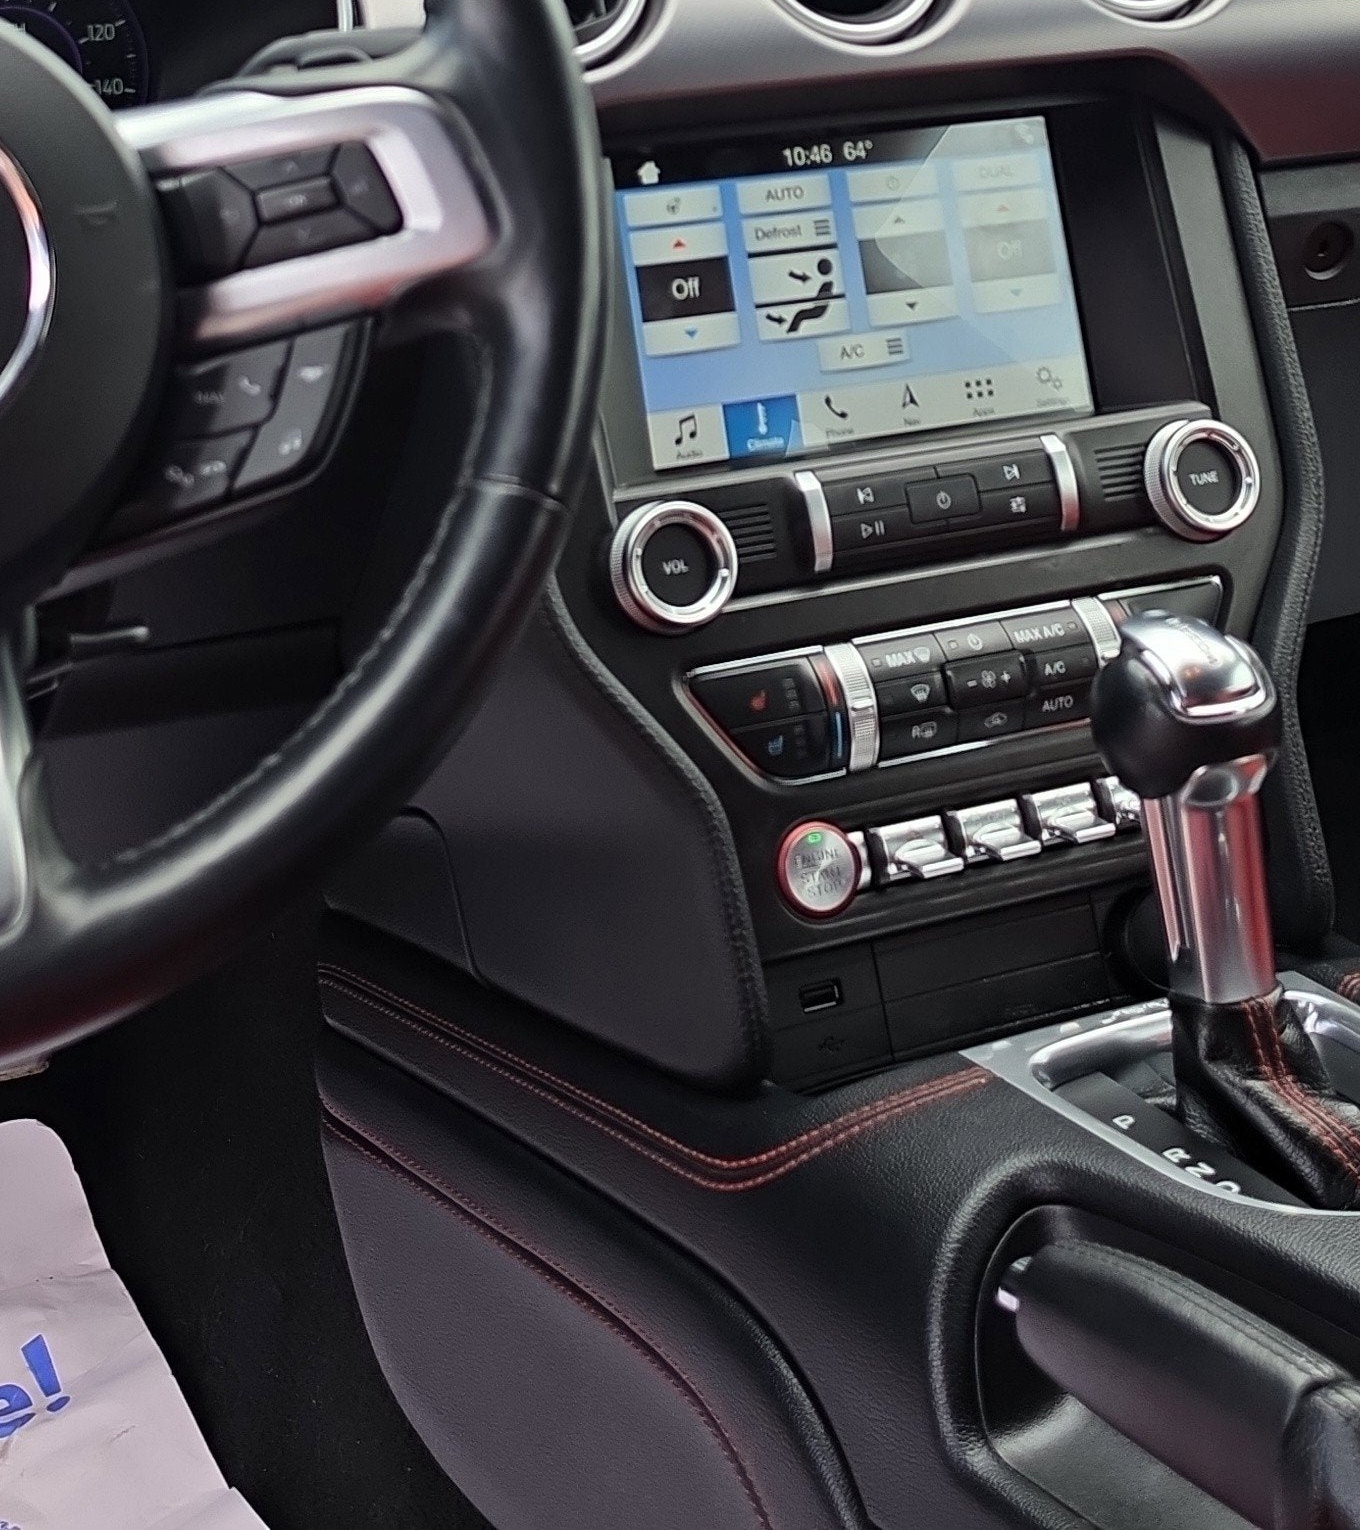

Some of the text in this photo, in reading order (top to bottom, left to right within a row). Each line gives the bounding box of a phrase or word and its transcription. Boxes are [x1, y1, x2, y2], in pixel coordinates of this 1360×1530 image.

[88, 24, 115, 42] 120
[96, 77, 124, 96] 140
[783, 143, 834, 167] 10:46
[765, 185, 805, 203] AUTO
[754, 222, 802, 242] Defrost
[671, 278, 701, 302] Off
[839, 342, 866, 360] A/C
[1189, 469, 1219, 488] TUNE
[662, 559, 689, 576] VOL
[1014, 622, 1066, 644] MAX A/C
[885, 652, 916, 668] MAX
[1044, 660, 1066, 676] A/C
[1042, 695, 1074, 713] AUTO
